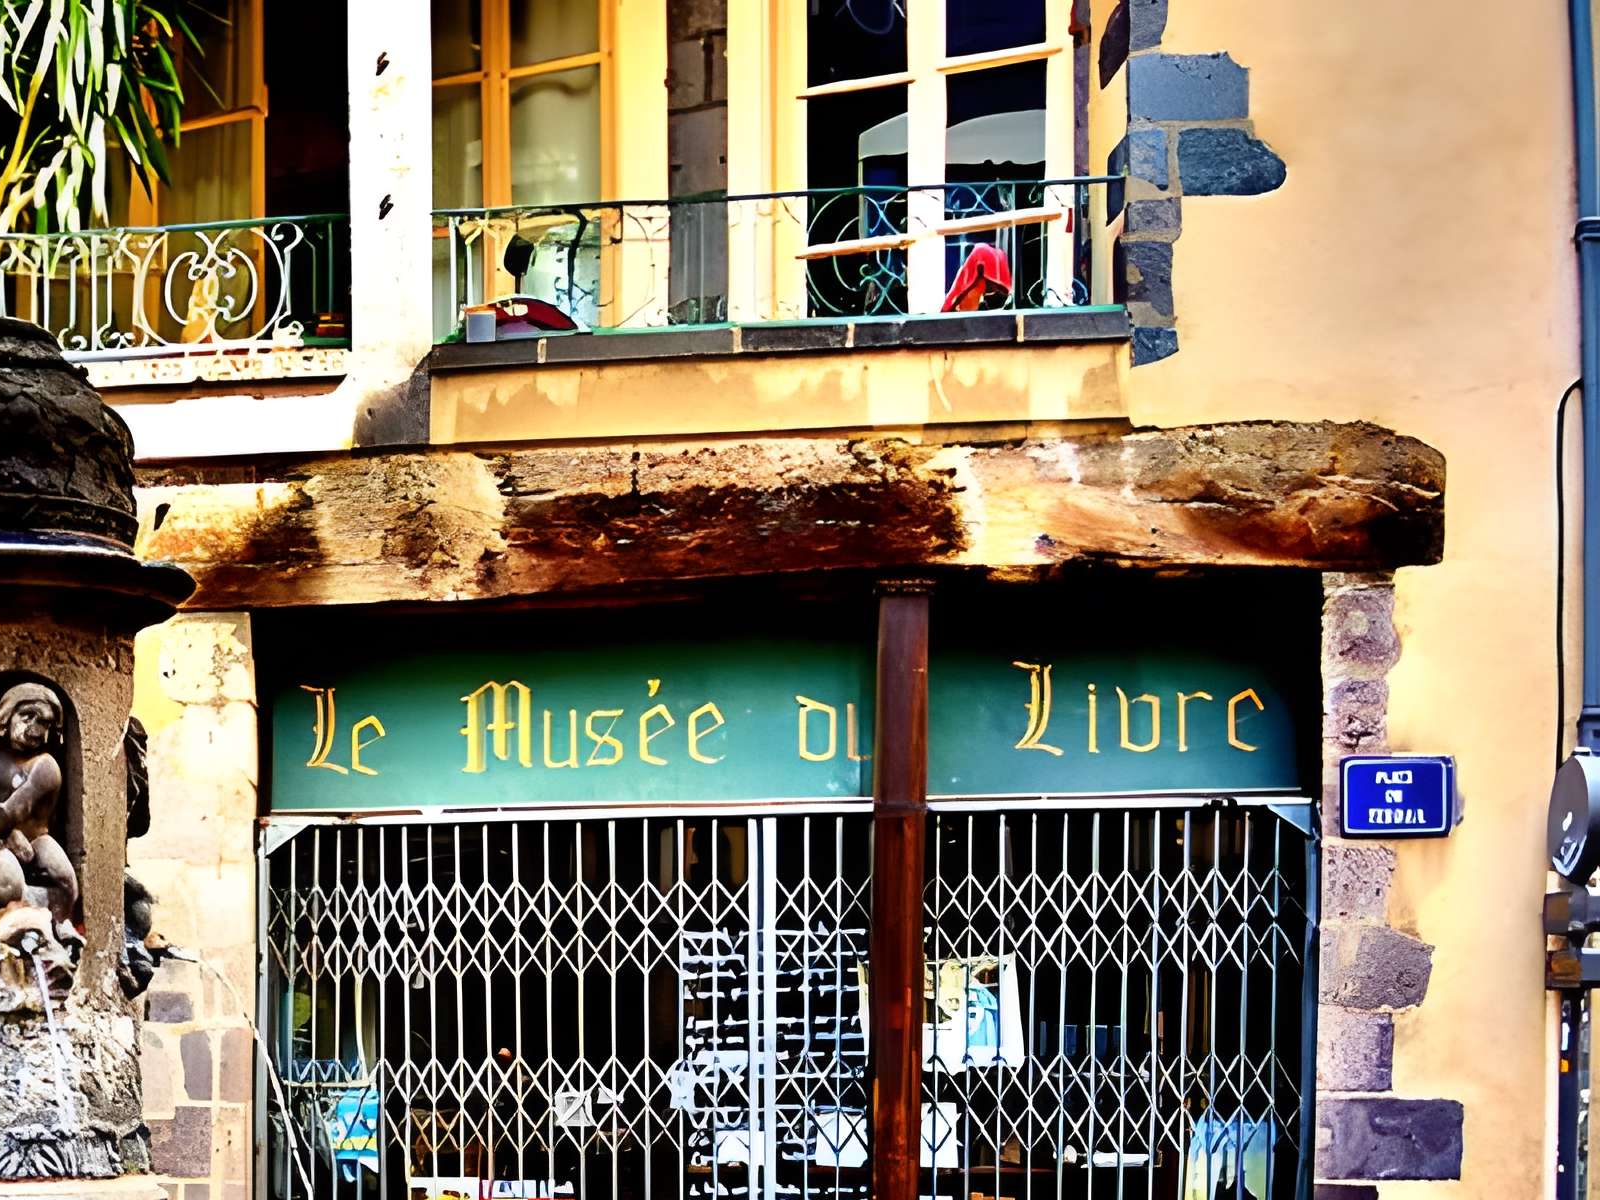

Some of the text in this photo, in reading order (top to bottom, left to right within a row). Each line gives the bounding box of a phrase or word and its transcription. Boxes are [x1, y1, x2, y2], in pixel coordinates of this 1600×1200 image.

[299, 684, 385, 776] Le
[460, 678, 727, 774] Musée
[1012, 660, 1265, 756] Livre
